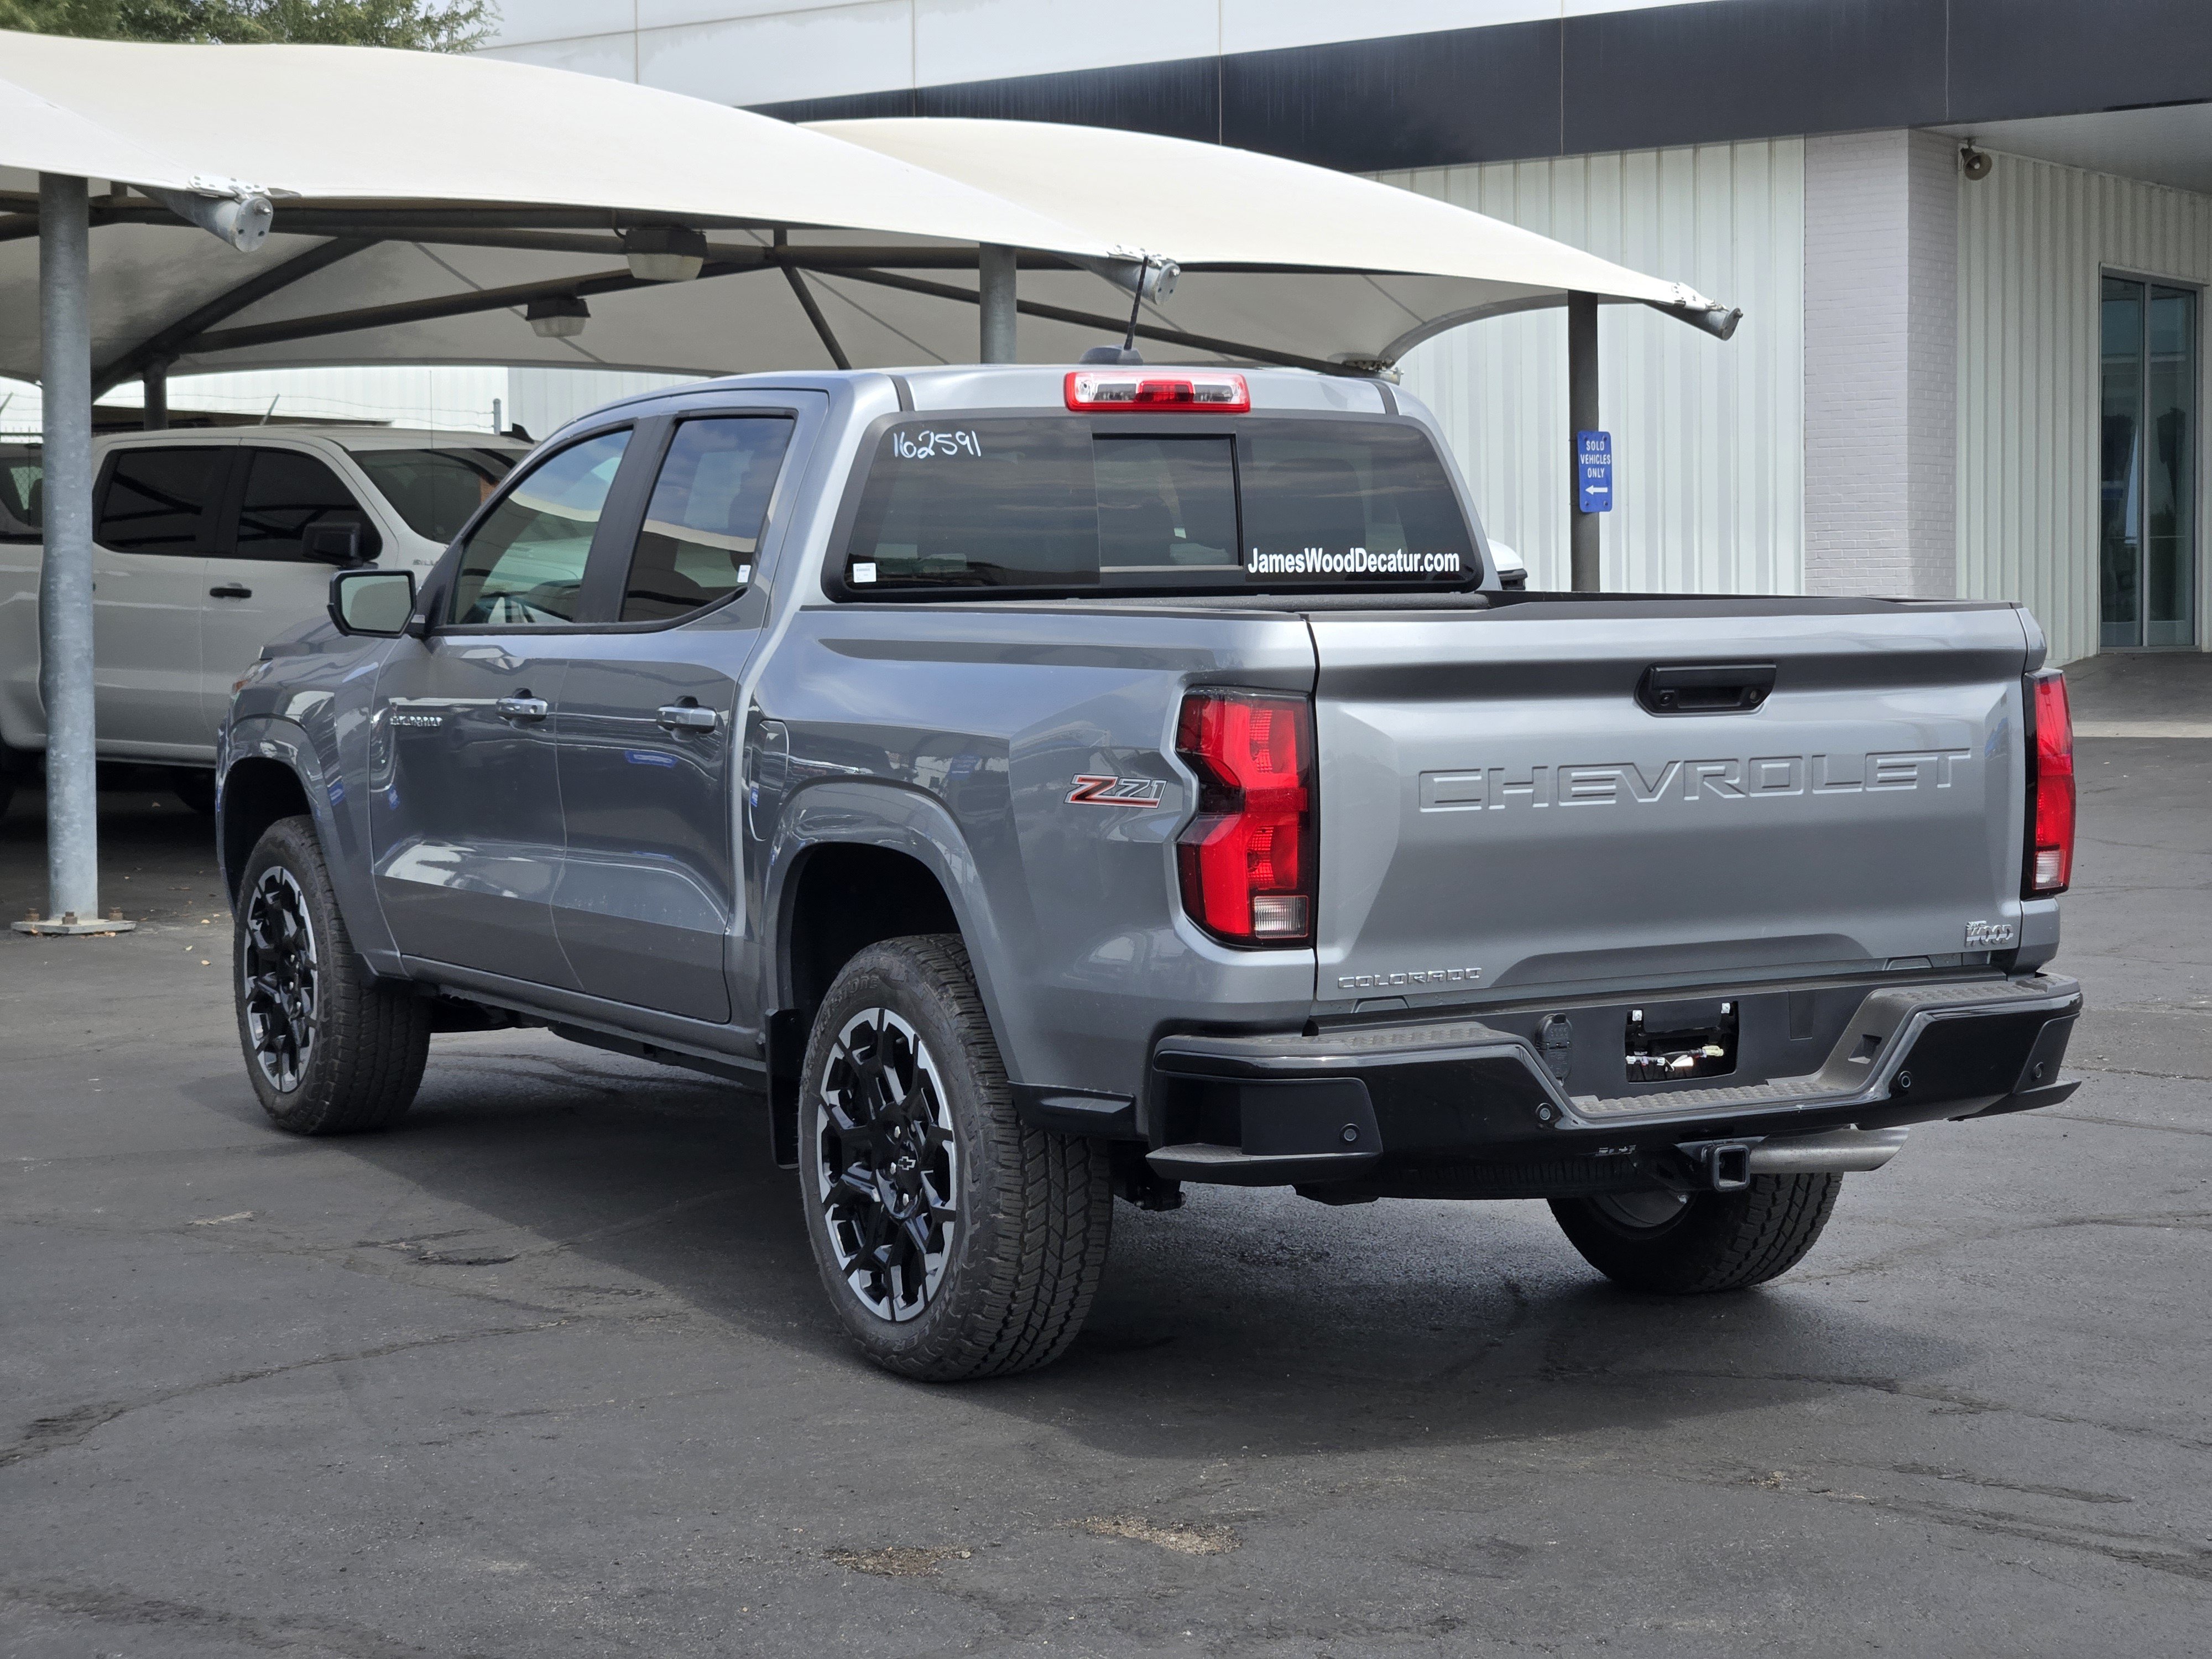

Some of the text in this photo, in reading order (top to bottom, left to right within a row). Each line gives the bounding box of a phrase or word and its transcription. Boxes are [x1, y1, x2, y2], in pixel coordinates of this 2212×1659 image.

[893, 430, 982, 459] 162591
[1586, 441, 1604, 451] SOLD
[1580, 454, 1611, 465] VEHICLES
[1587, 467, 1605, 478] ONLY
[1247, 547, 1460, 573] JamesWoodDecatur.com
[1063, 773, 1168, 809] Z71
[1418, 748, 1971, 812] CHEVROLET
[1338, 967, 1483, 989] COLORADO
